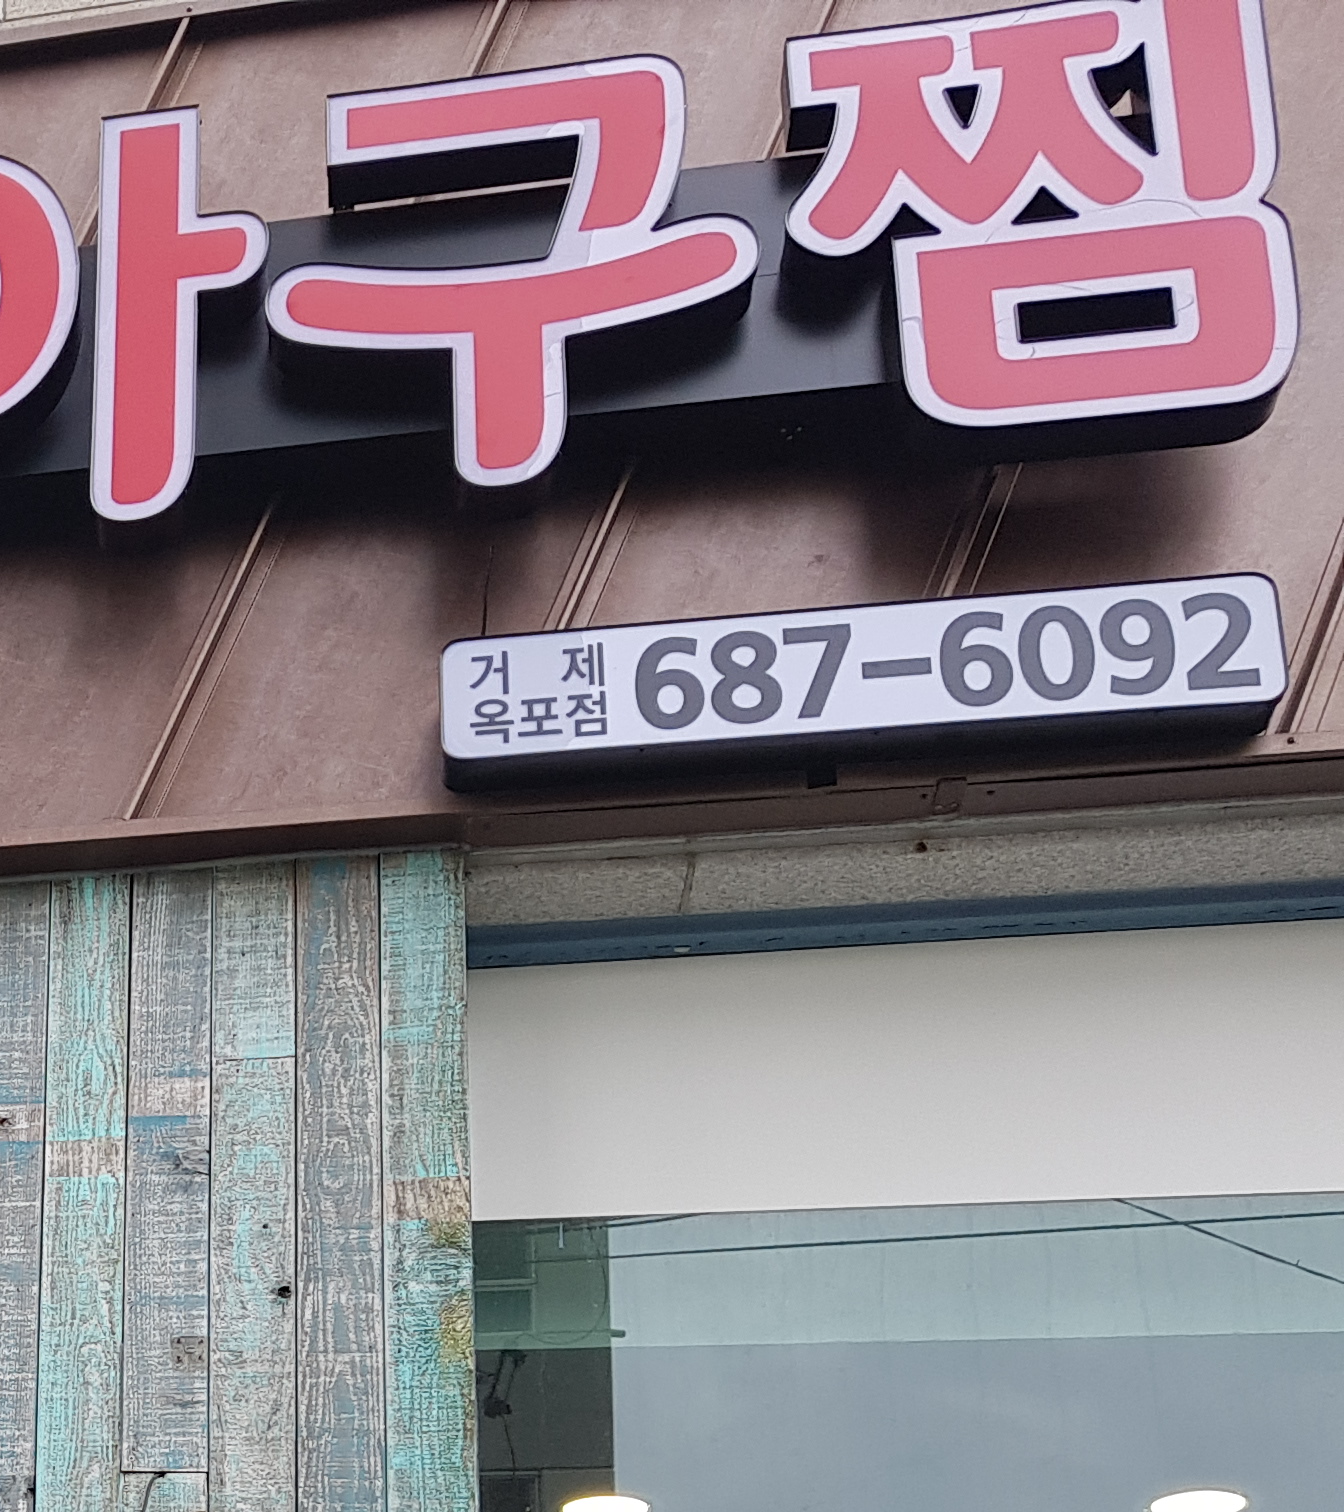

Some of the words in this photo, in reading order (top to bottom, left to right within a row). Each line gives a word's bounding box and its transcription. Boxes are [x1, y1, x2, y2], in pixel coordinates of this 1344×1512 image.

[469, 641, 606, 694] 거제
[634, 592, 1262, 730] 687-6092
[469, 692, 610, 743] 옥포점
